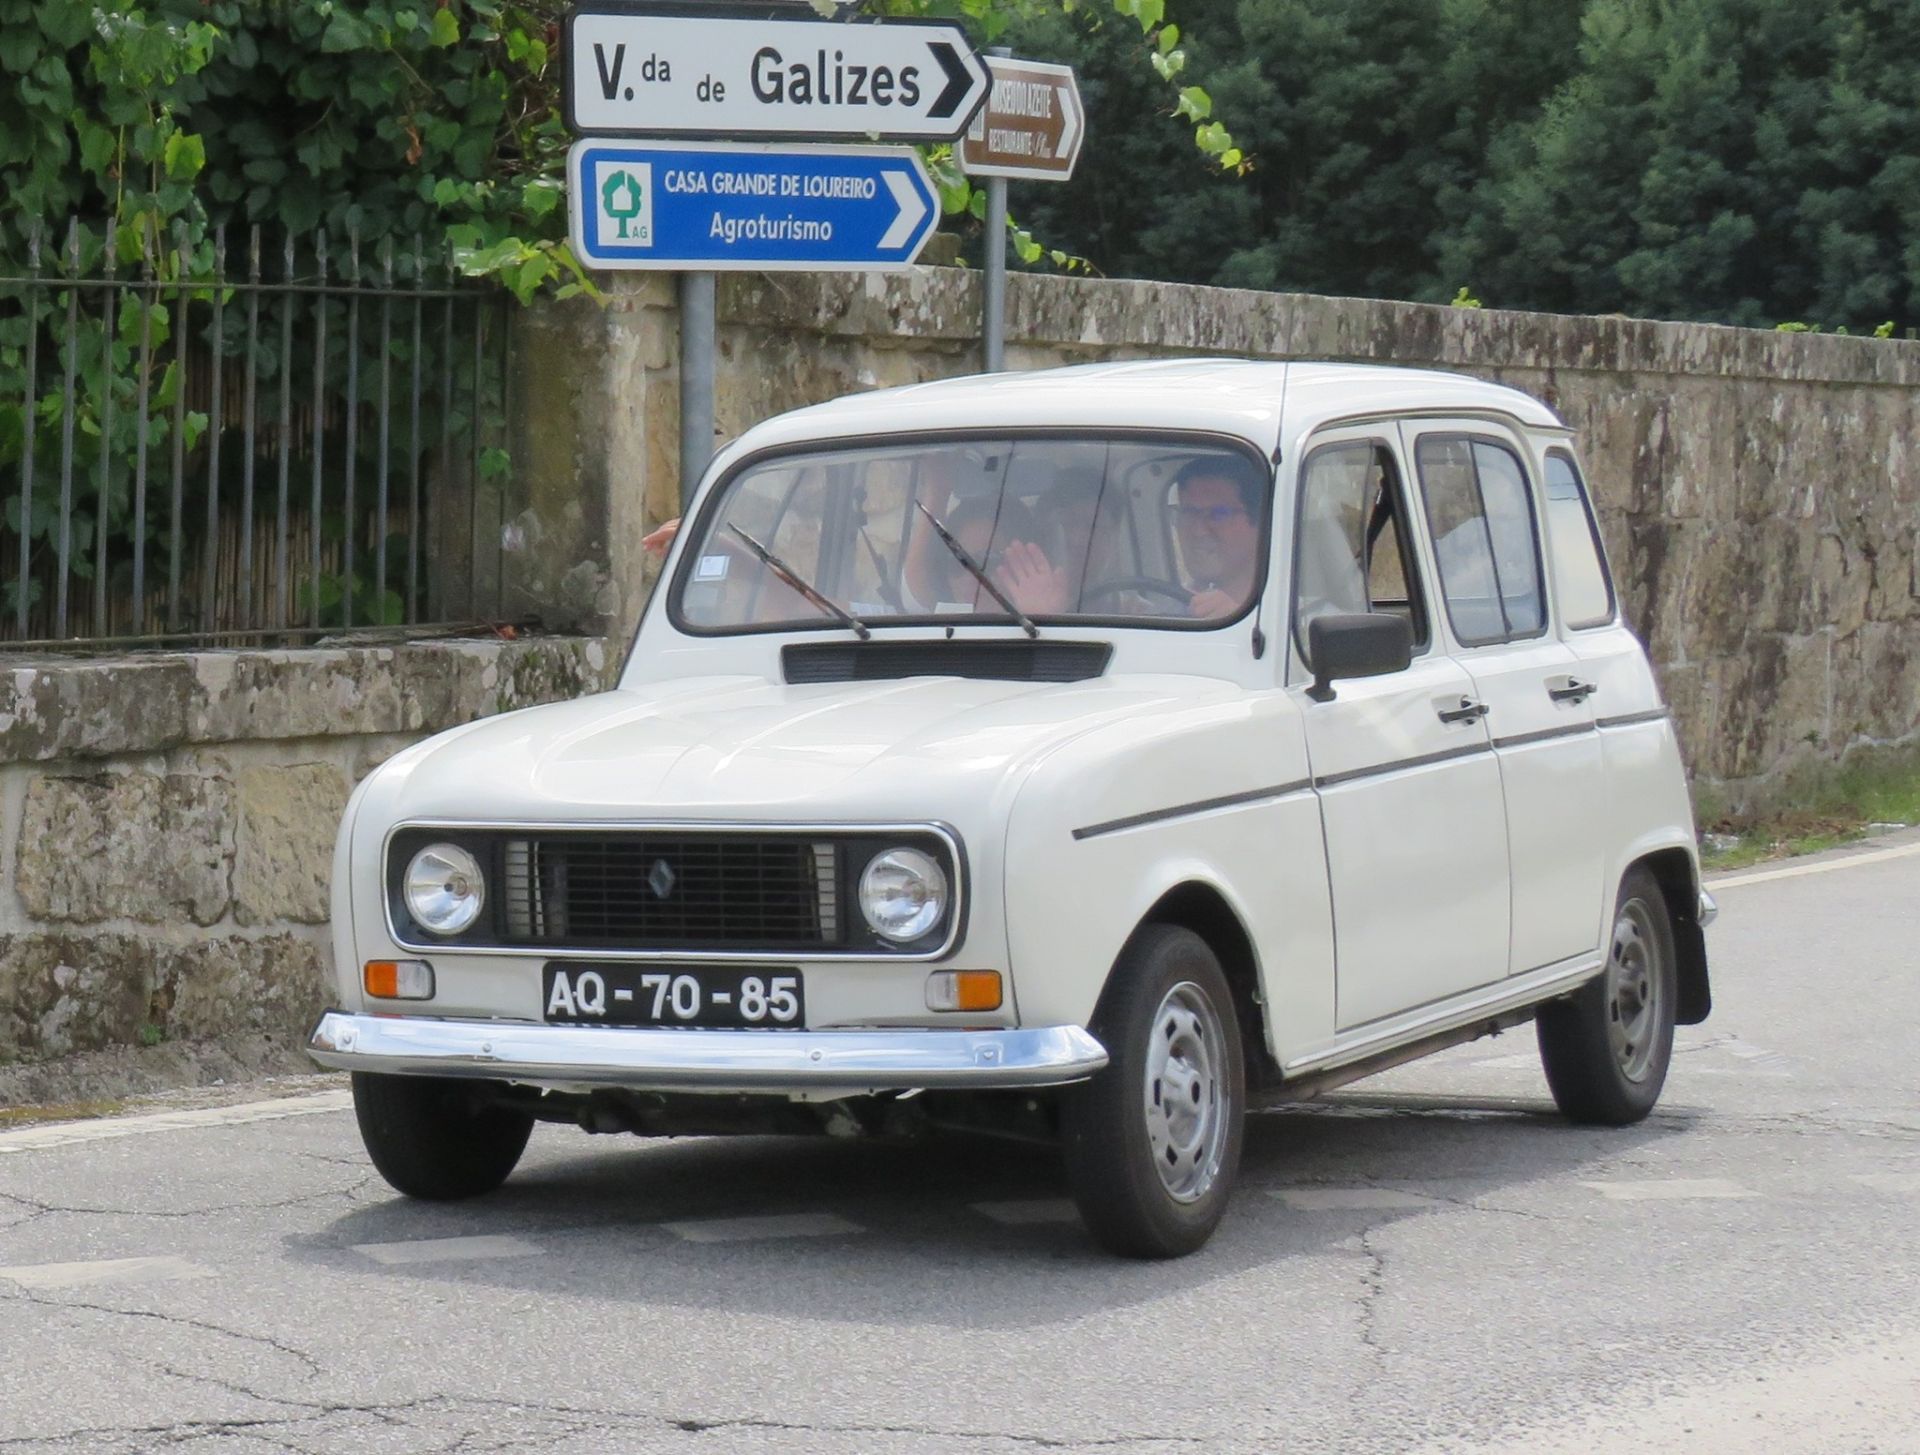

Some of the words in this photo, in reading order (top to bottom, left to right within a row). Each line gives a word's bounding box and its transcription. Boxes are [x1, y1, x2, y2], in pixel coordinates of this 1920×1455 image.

[696, 73, 725, 102] de
[750, 46, 920, 107] Galizes
[664, 170, 708, 194] CASA
[712, 171, 777, 196] GRANDE
[780, 174, 800, 196] DE
[803, 175, 876, 199] LOUREIRO
[632, 226, 648, 239] AG
[709, 211, 833, 244] Agroturismo
